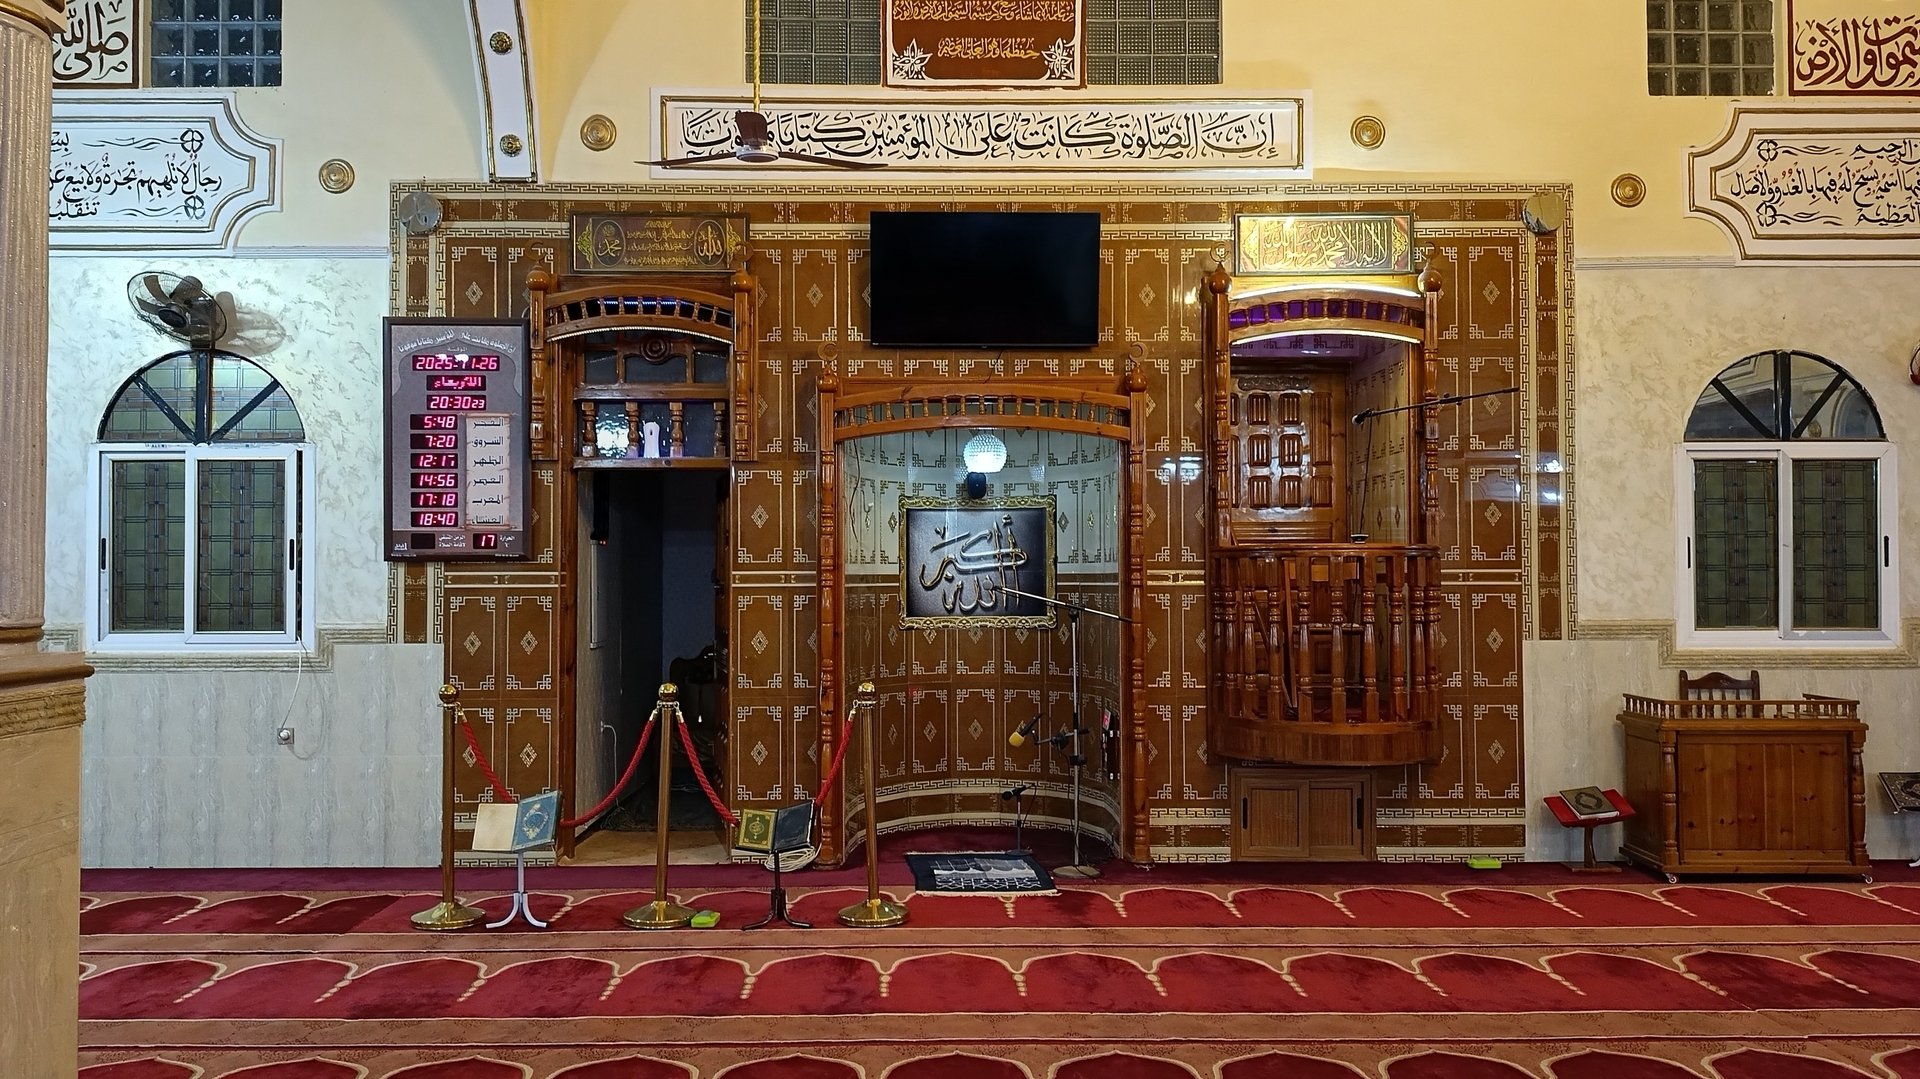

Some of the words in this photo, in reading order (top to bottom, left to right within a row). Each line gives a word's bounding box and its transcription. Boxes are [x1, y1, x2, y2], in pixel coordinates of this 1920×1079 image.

[1000, 37, 1040, 59] حفظهما
[822, 112, 935, 159] المؤمنين
[1015, 112, 1117, 158] كانت
[1850, 138, 1913, 163] الرحيم
[181, 162, 222, 195] رجال
[1813, 166, 1840, 204] فيها
[1838, 164, 1851, 196] له
[598, 239, 622, 257] محمد
[698, 225, 723, 260] الله
[416, 356, 498, 370] 2025-11-26
[423, 416, 456, 429] 5:48
[425, 435, 456, 448] 7:20
[419, 455, 455, 467] 12:17
[473, 455, 504, 467] الظهر
[419, 474, 456, 487] 14:56
[473, 475, 504, 487] العصر
[419, 494, 456, 506] 17:18
[472, 494, 504, 506] المغرب
[420, 513, 456, 526] 18:40
[481, 535, 495, 547] 17
